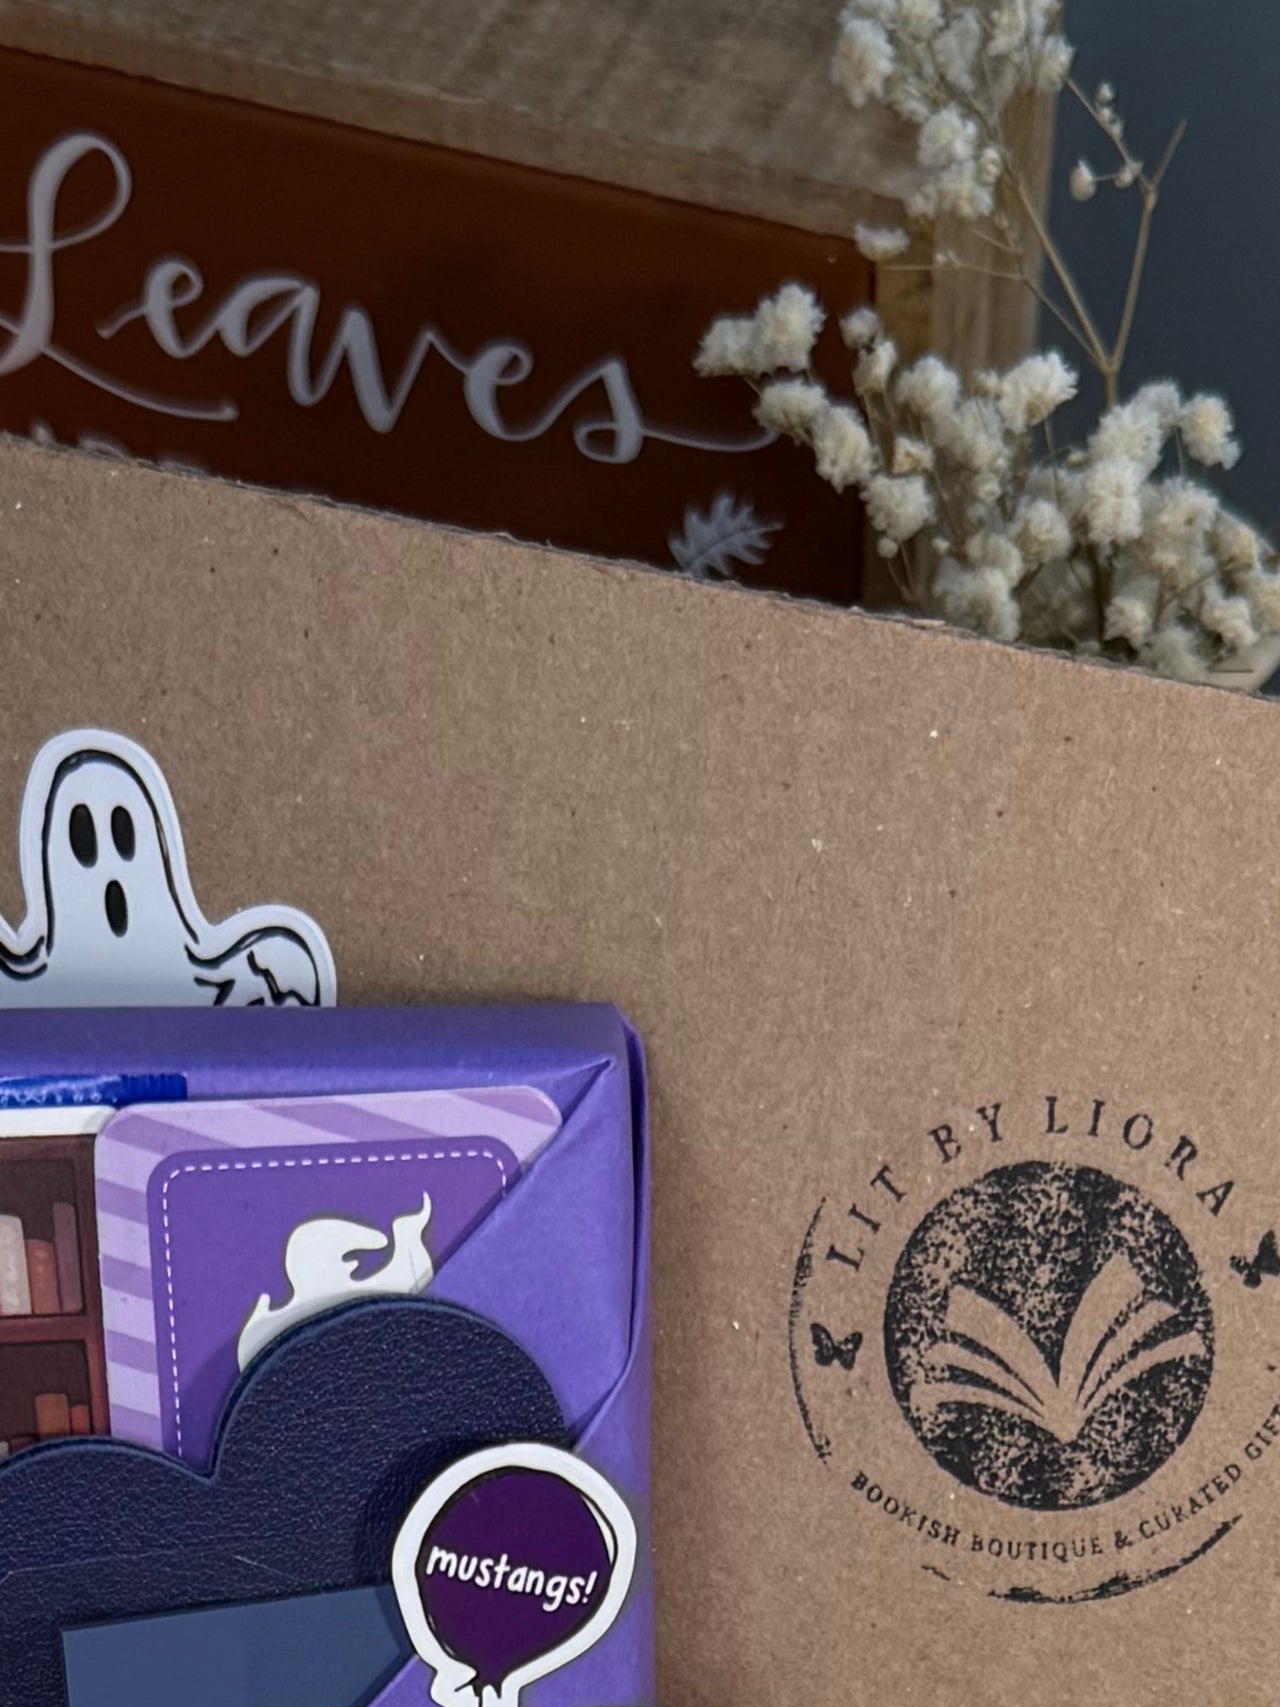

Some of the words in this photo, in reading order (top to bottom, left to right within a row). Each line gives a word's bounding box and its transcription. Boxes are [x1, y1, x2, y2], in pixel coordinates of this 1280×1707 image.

[827, 1165, 908, 1271] LIT
[927, 1102, 1004, 1164] BY
[1045, 1096, 1236, 1217] LIORA
[850, 1470, 960, 1548] BOOKISH
[970, 1532, 1105, 1563] BOUTIQUE
[1114, 1529, 1133, 1549] &
[1139, 1462, 1244, 1540] CURATED
[426, 1543, 599, 1612] mustangs!
